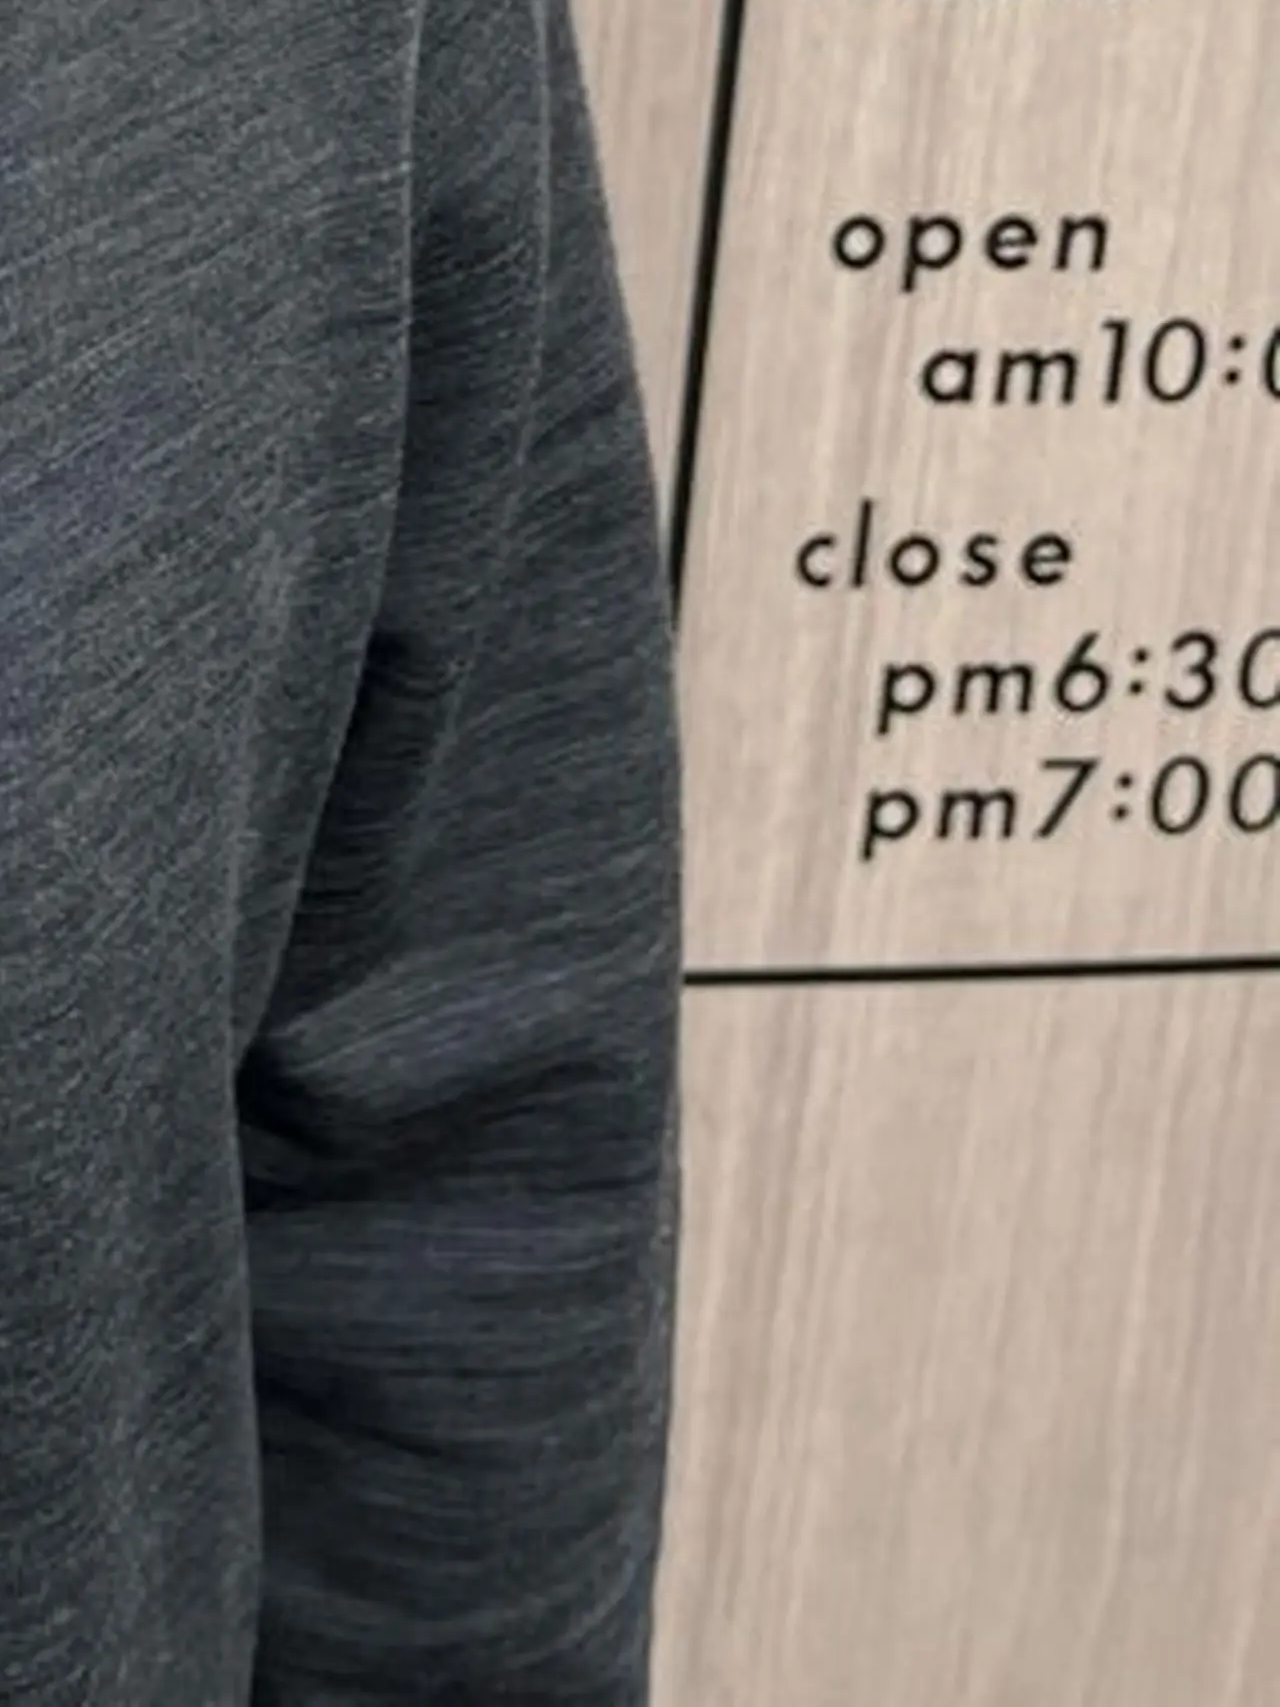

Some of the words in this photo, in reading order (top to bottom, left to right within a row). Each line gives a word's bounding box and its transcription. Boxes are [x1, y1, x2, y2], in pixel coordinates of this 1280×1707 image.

[831, 214, 1109, 295] open
[919, 316, 1280, 407] am10:
[794, 497, 1074, 590] close
[875, 627, 1280, 738] pm6:30
[859, 752, 1280, 864] pm7:00
